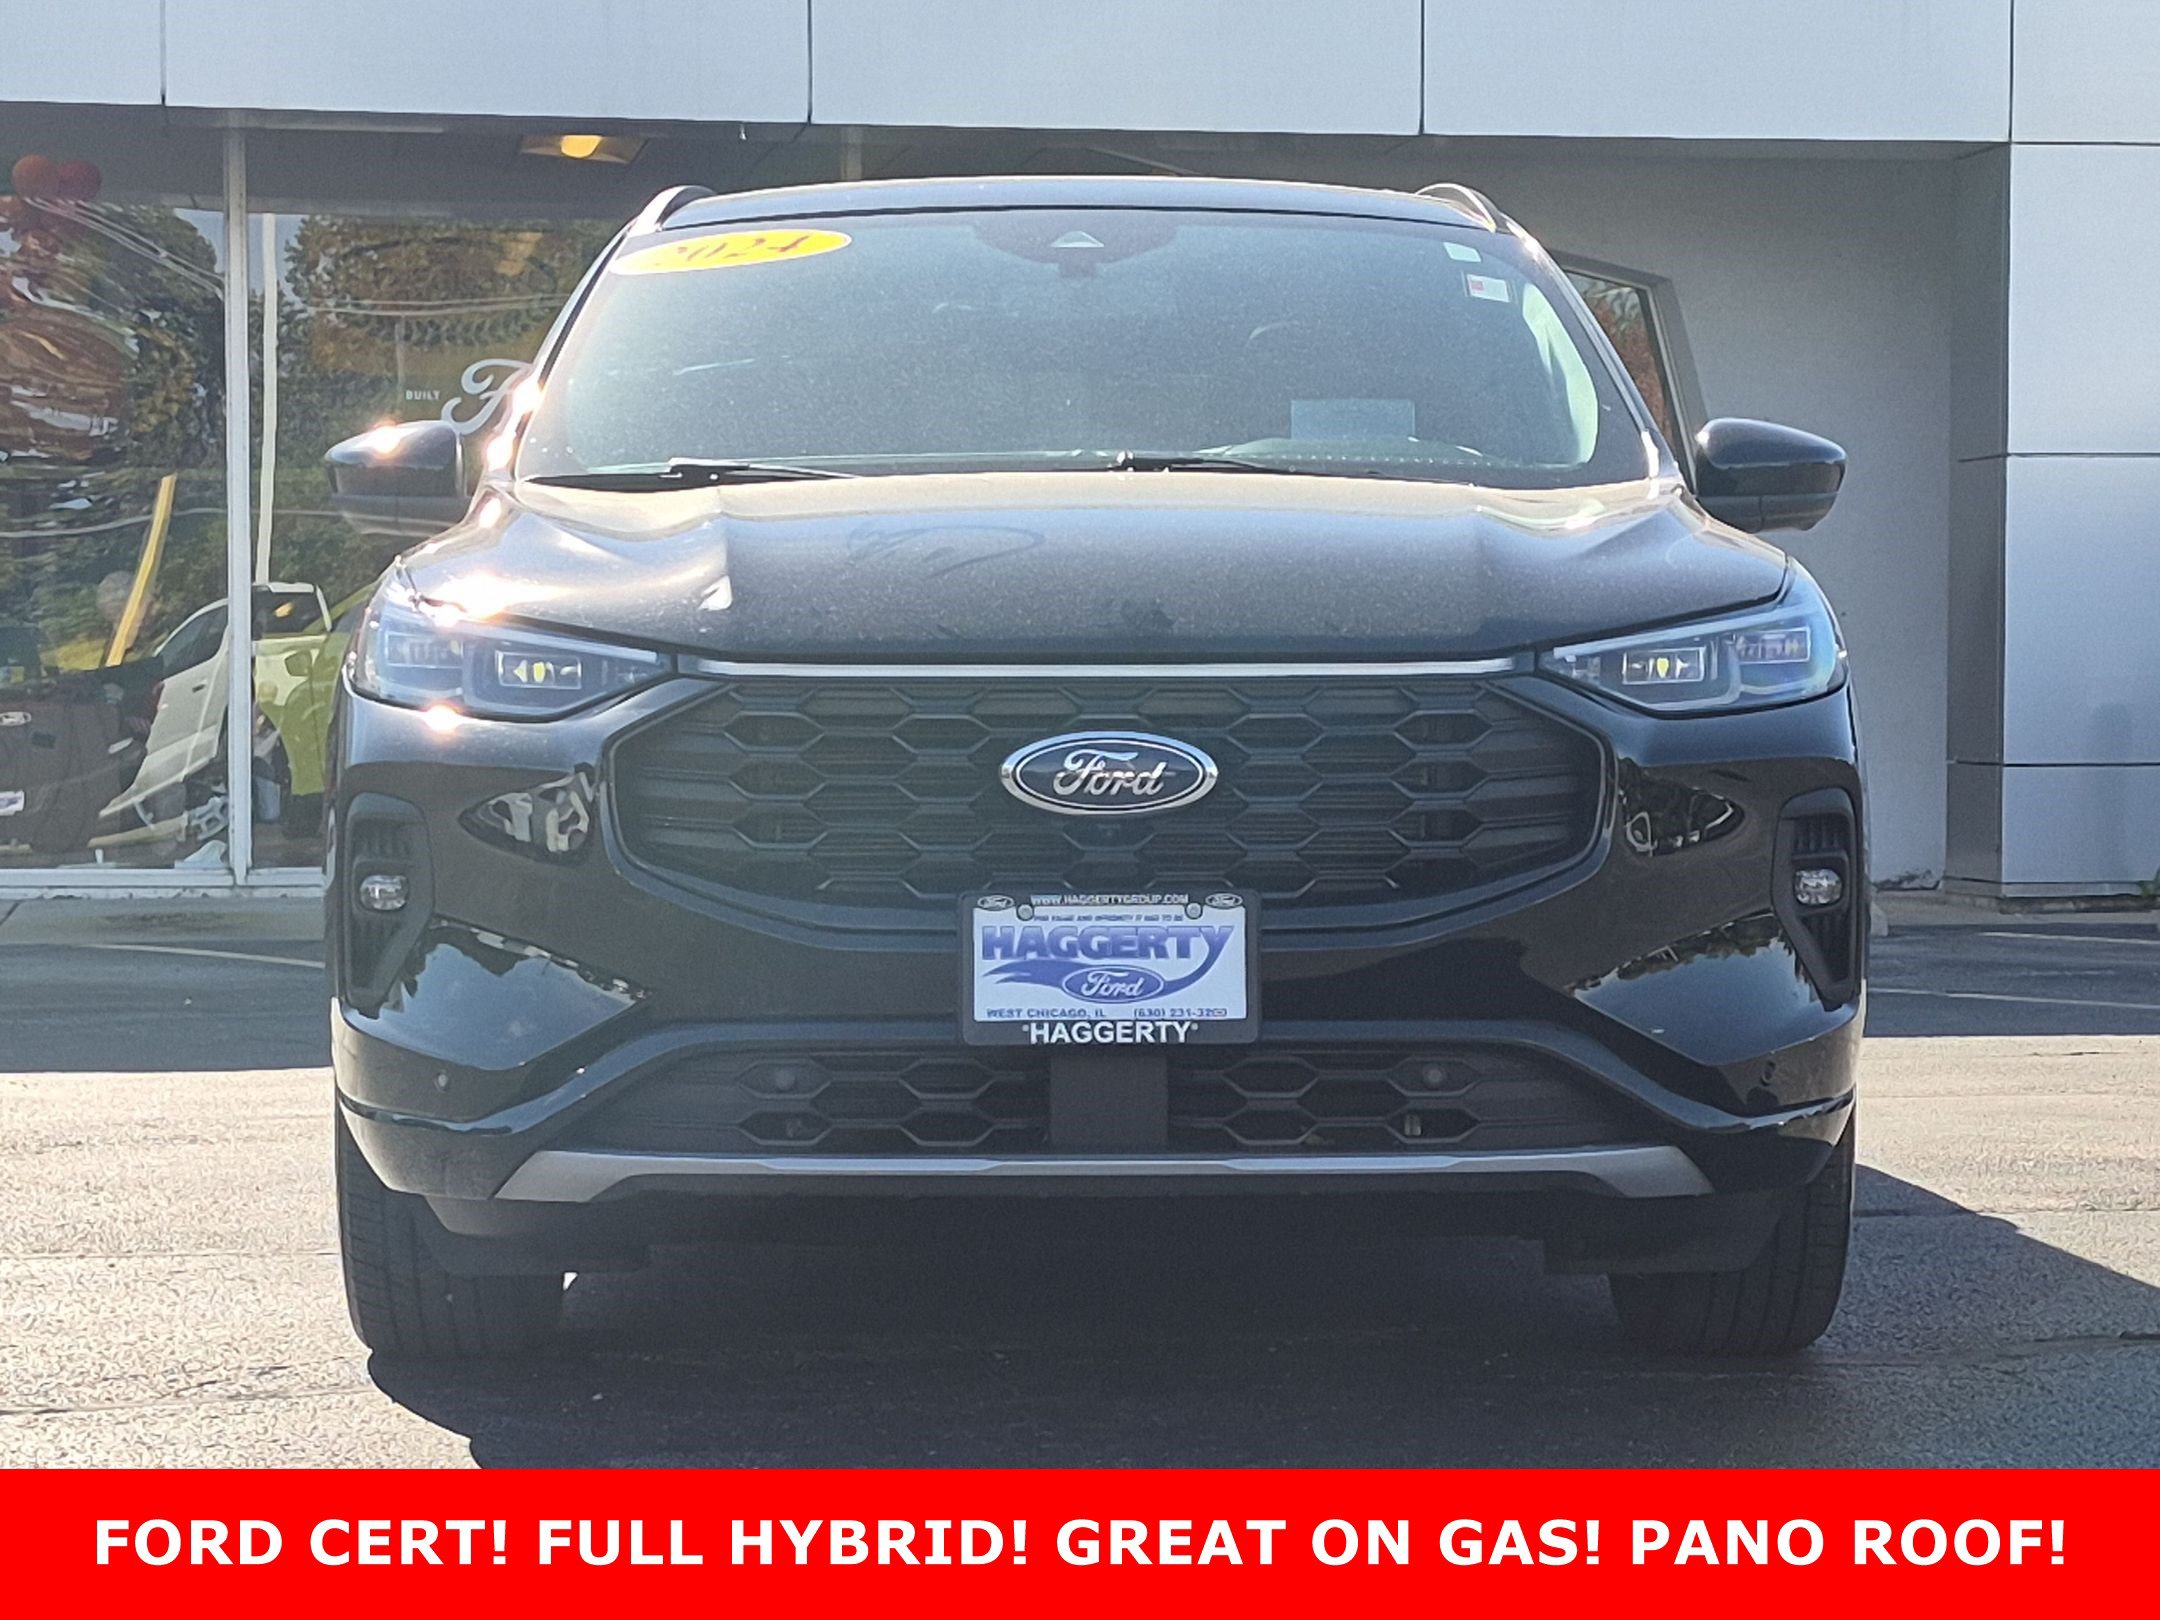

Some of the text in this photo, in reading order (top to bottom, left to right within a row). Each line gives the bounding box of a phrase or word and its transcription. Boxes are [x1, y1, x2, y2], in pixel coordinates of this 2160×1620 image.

[405, 389, 441, 400] BUILT
[1053, 748, 1167, 795] Ford
[982, 925, 1234, 960] HAGGERTY
[1080, 970, 1144, 997] Ford
[986, 1008, 1022, 1018] WEST
[1095, 1008, 1106, 1018] IL
[1133, 1007, 1165, 1019] (630)
[1030, 1021, 1191, 1044] HAGGERTY
